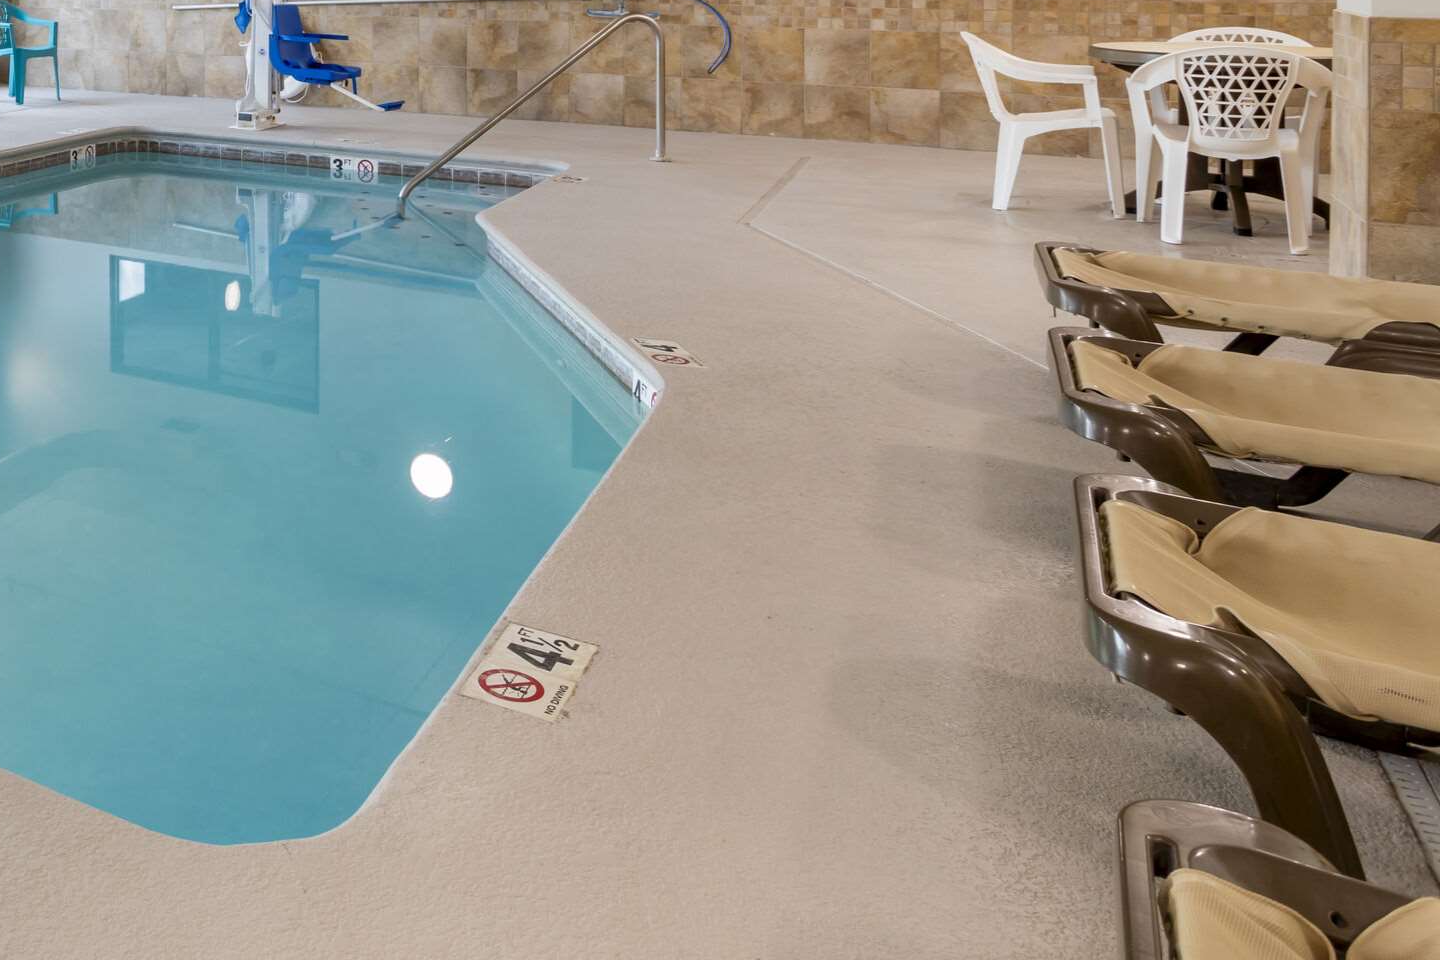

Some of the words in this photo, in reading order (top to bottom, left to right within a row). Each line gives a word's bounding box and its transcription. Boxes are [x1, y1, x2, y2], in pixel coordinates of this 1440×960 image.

[634, 379, 641, 402] 4
[517, 627, 535, 639] FT
[507, 642, 575, 672] 4
[544, 704, 556, 716] NO
[550, 685, 569, 705] DIVING
